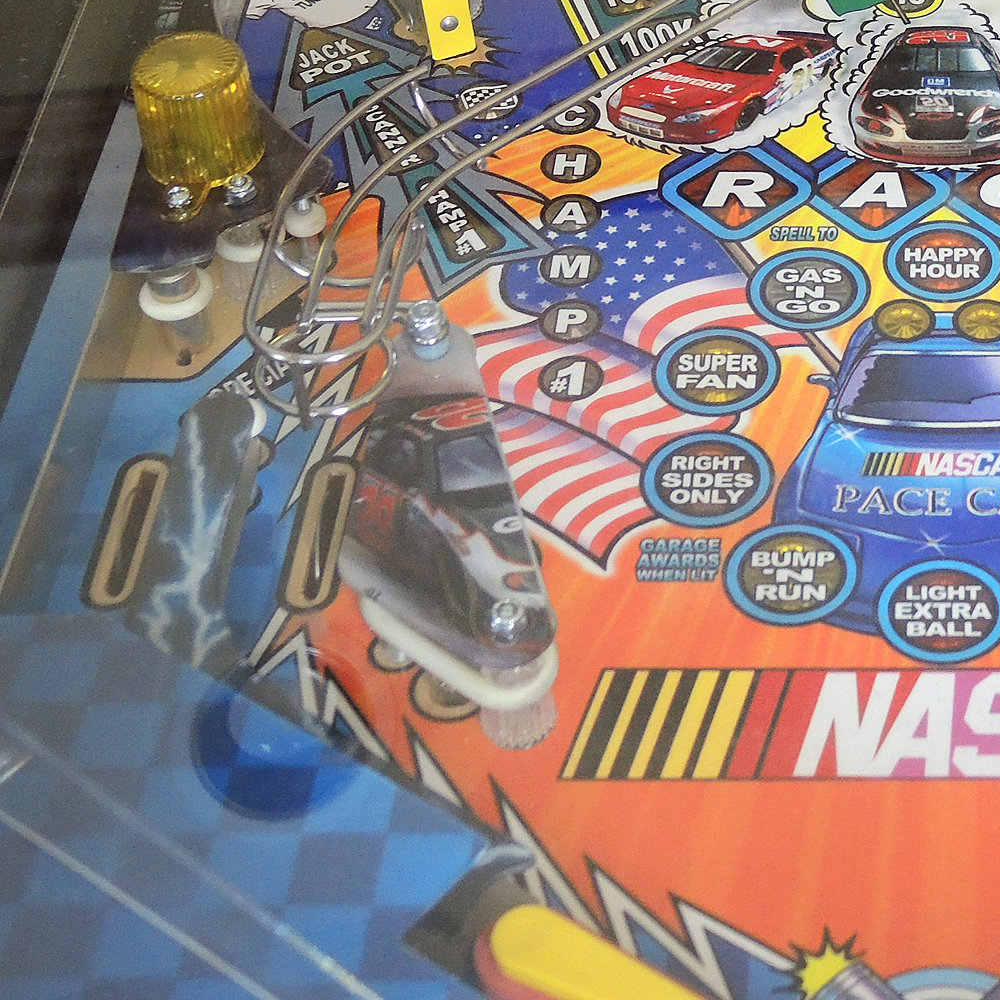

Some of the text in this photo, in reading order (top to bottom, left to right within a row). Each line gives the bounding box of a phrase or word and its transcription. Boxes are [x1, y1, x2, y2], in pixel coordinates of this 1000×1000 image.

[299, 38, 355, 68] JACK
[299, 50, 370, 84] POT
[872, 87, 1000, 98] Goodwrench
[769, 226, 839, 242] SPELL TO
[903, 246, 986, 264] HAPPY
[775, 267, 843, 284] GAS
[909, 262, 980, 279] HOUR
[775, 299, 841, 315] GO
[677, 353, 758, 375] SUPER
[549, 361, 589, 396] #1
[675, 371, 757, 390] FAN
[672, 455, 744, 473] RIGHT
[662, 471, 753, 488] SIDES
[671, 485, 745, 506] ONLY
[834, 485, 952, 516] PACE
[640, 538, 721, 553] GARAGE
[637, 552, 720, 568] AWARDS
[751, 549, 836, 568] BUMP
[637, 568, 717, 582] WHEN LIT
[755, 582, 827, 602] RUN
[906, 585, 981, 602] LIGHT
[894, 601, 992, 622] EXTRA
[906, 619, 982, 639] BALL
